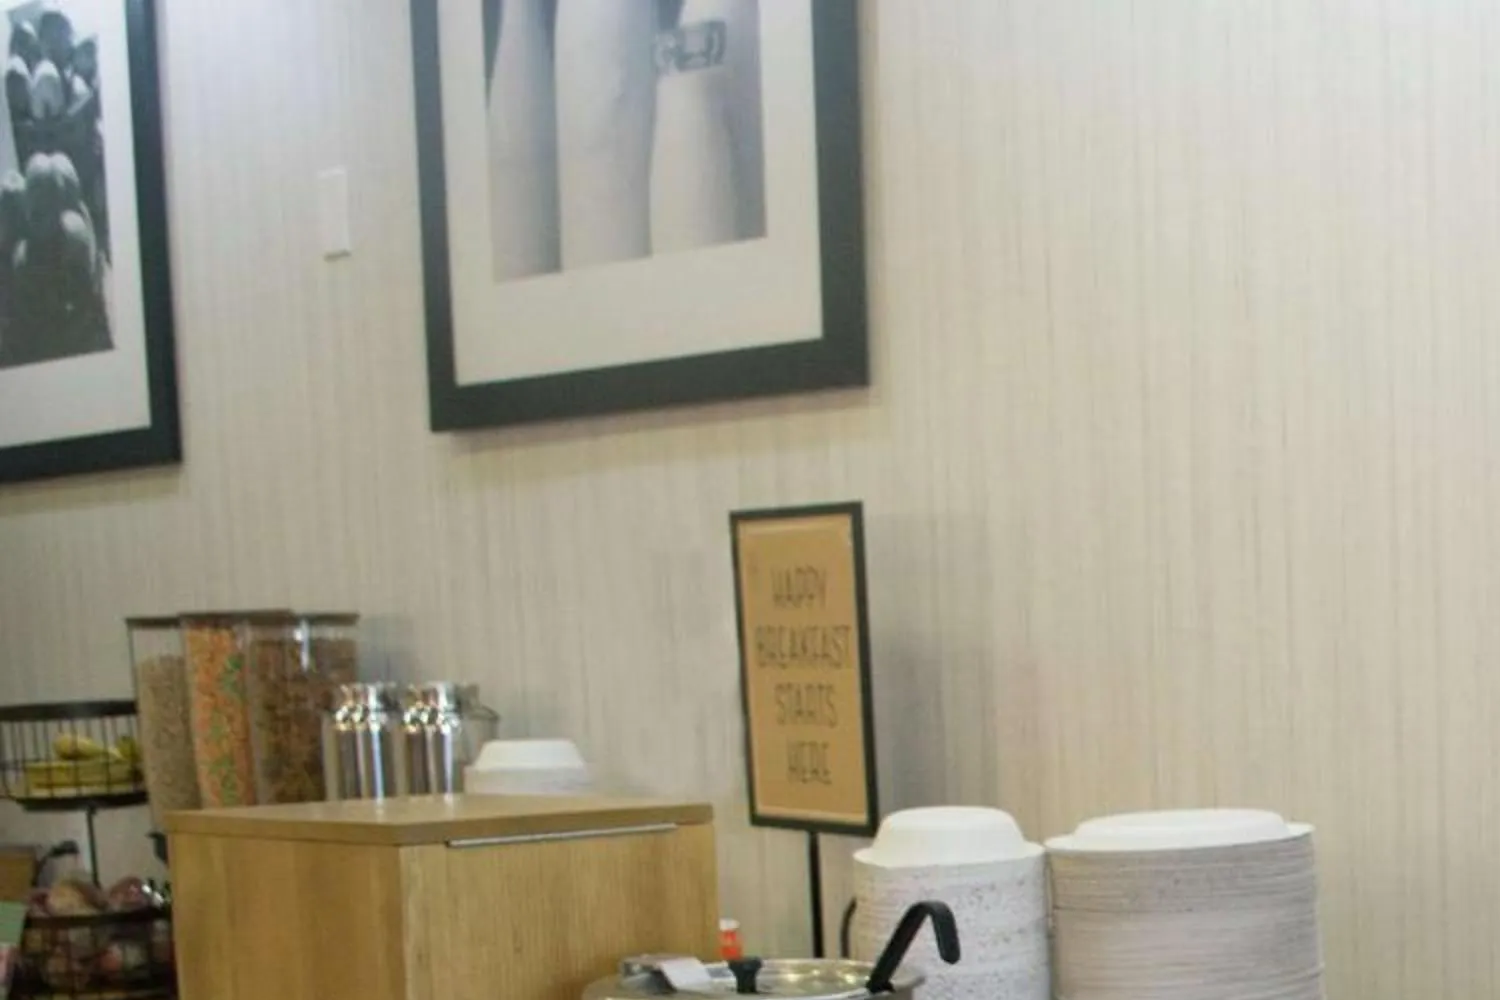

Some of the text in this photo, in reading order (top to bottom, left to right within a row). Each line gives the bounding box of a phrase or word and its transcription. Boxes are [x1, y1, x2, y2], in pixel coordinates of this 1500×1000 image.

[769, 564, 828, 609] HAPPY
[755, 623, 853, 670] BREAKFAST
[773, 682, 839, 729] STARTS
[785, 738, 833, 786] HERE
